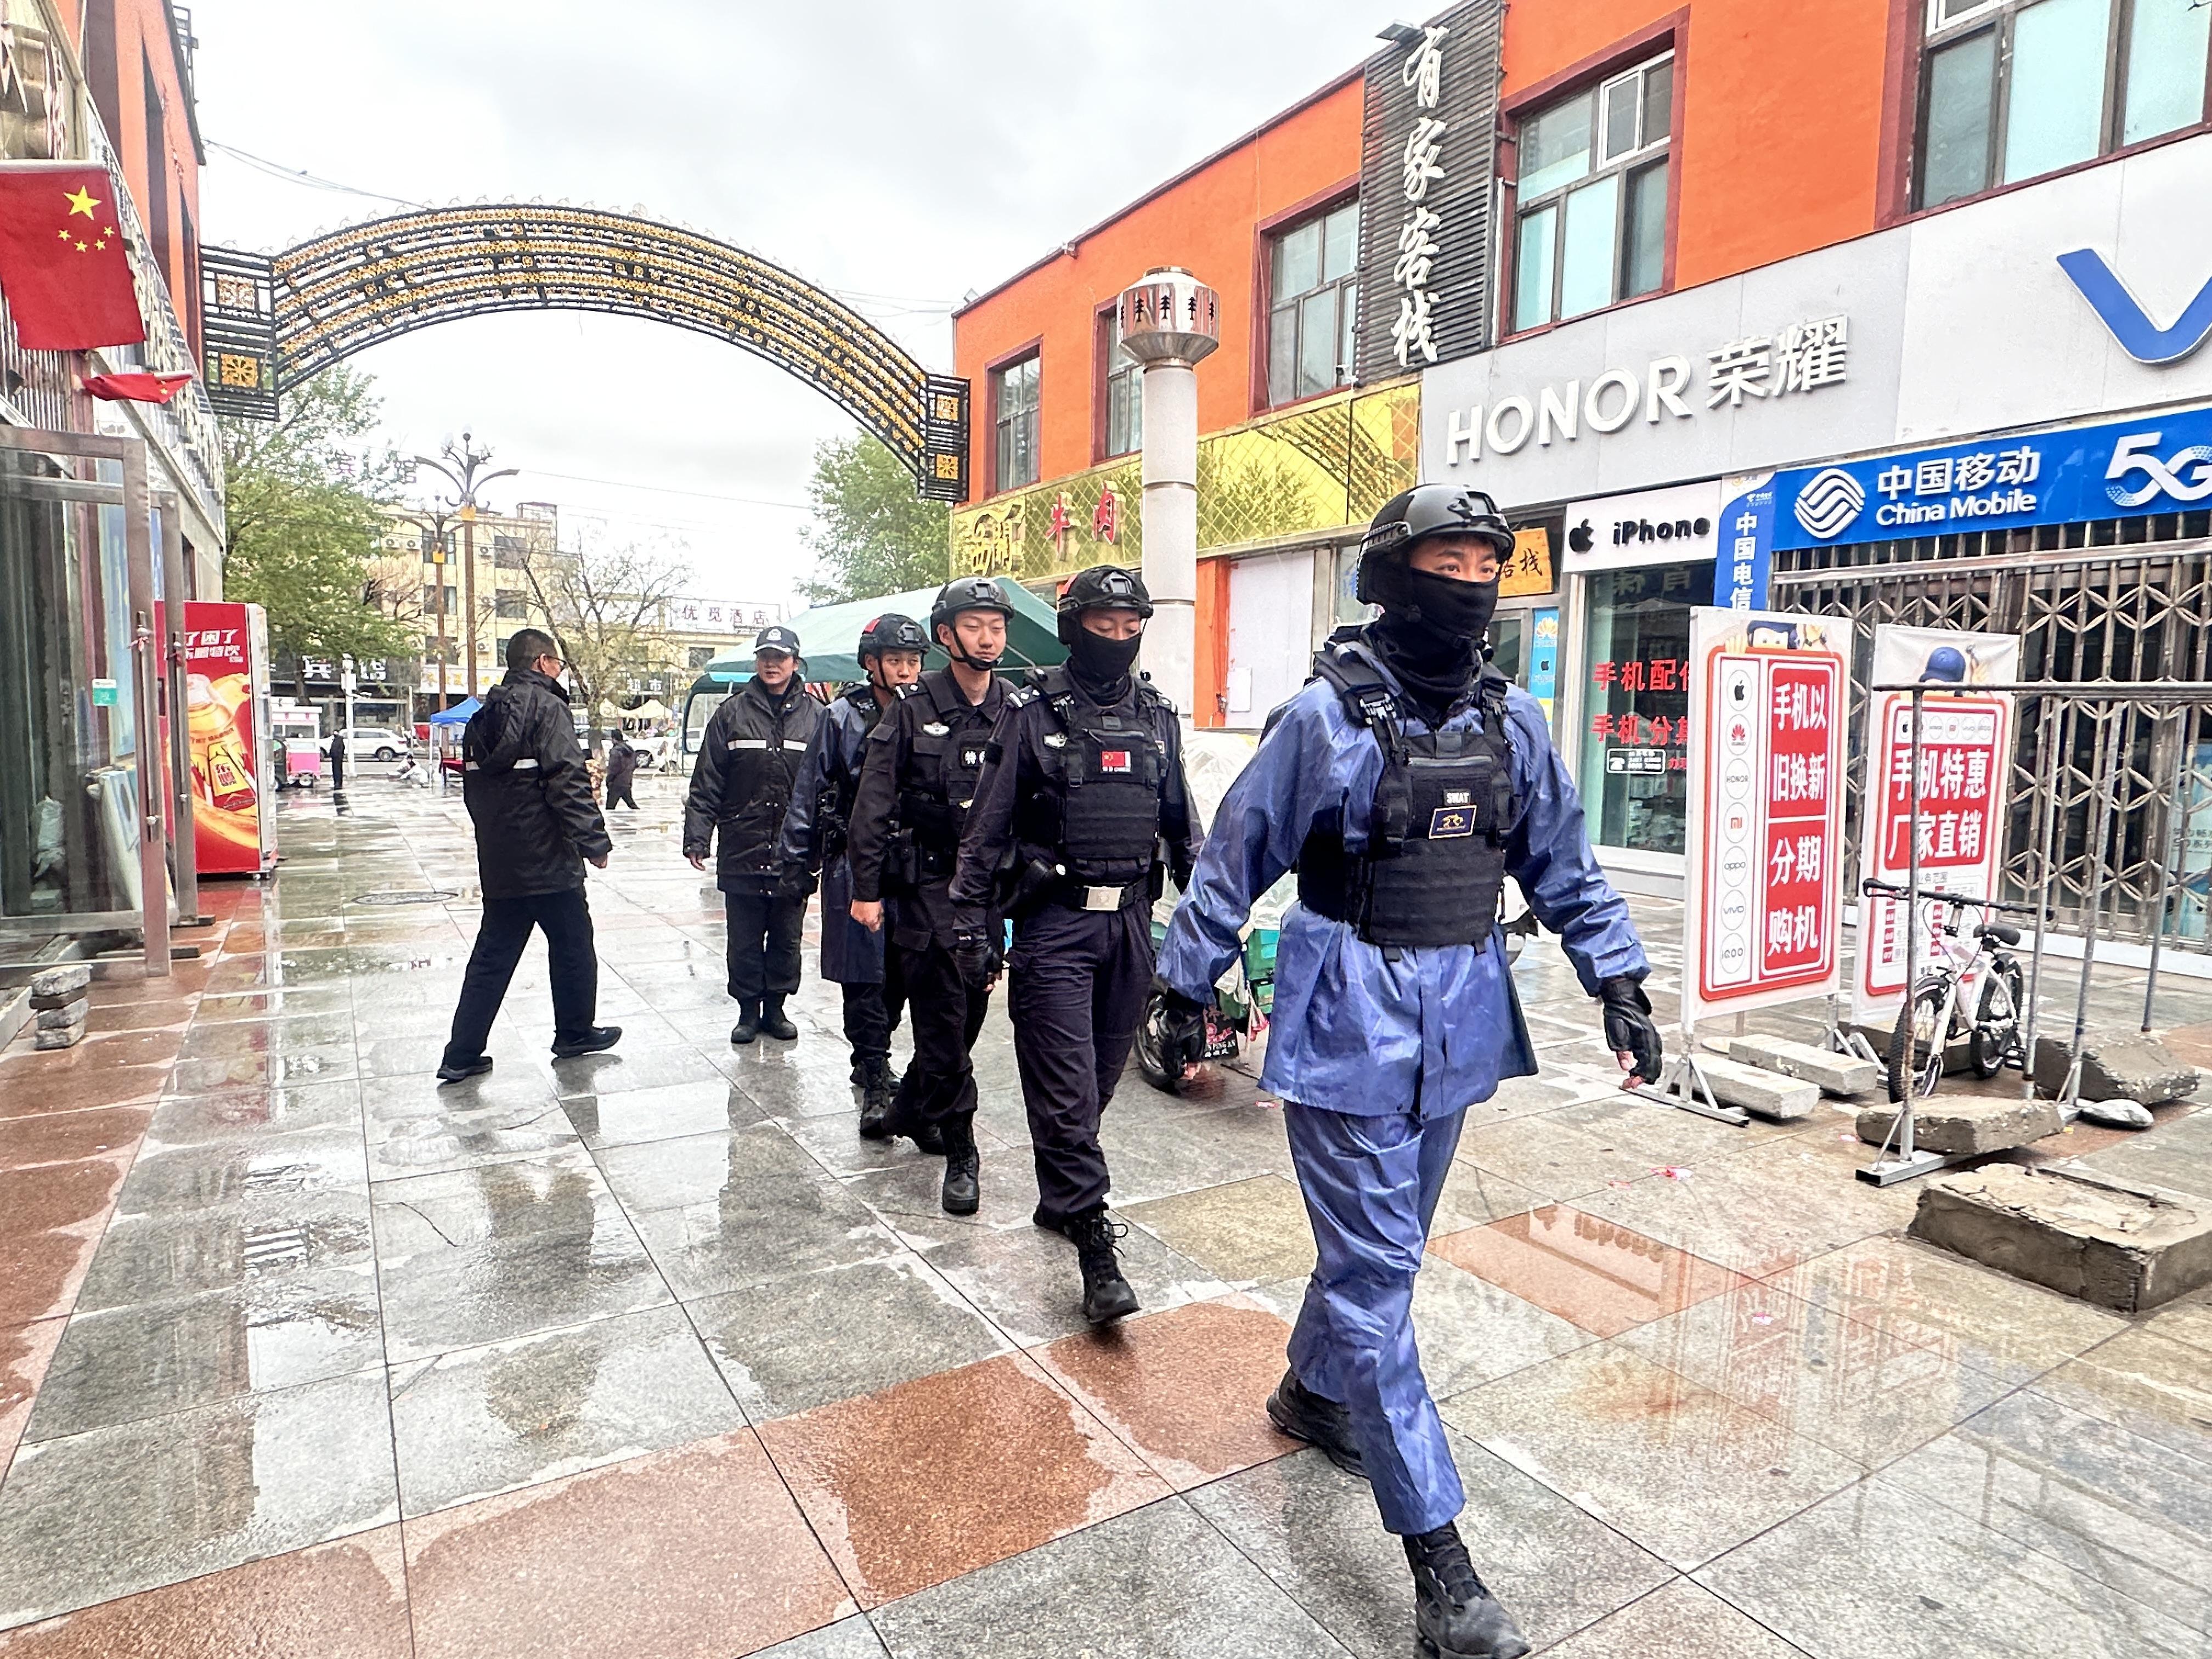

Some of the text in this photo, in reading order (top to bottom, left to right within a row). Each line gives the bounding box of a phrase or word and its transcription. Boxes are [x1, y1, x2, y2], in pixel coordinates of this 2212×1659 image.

[1391, 25, 1450, 368] 有家客栈
[1446, 313, 1848, 466] HONOR 荣耀
[1877, 445, 2041, 500] 中国移动
[2104, 432, 2212, 507] 5G
[1045, 477, 1116, 561] 牛肉
[1876, 488, 2037, 526] China Mobile
[1730, 511, 1758, 610] 中国电信
[682, 604, 766, 625] 优觅酒店
[1774, 681, 1827, 731] 手机以
[1446, 792, 1469, 804] SWAT
[1773, 752, 1826, 802] 旧换新
[1892, 748, 1990, 802] 手机特惠
[1770, 834, 1821, 887] 分期
[1888, 809, 1983, 861] 厂家直销
[1767, 904, 1819, 957] 购机
